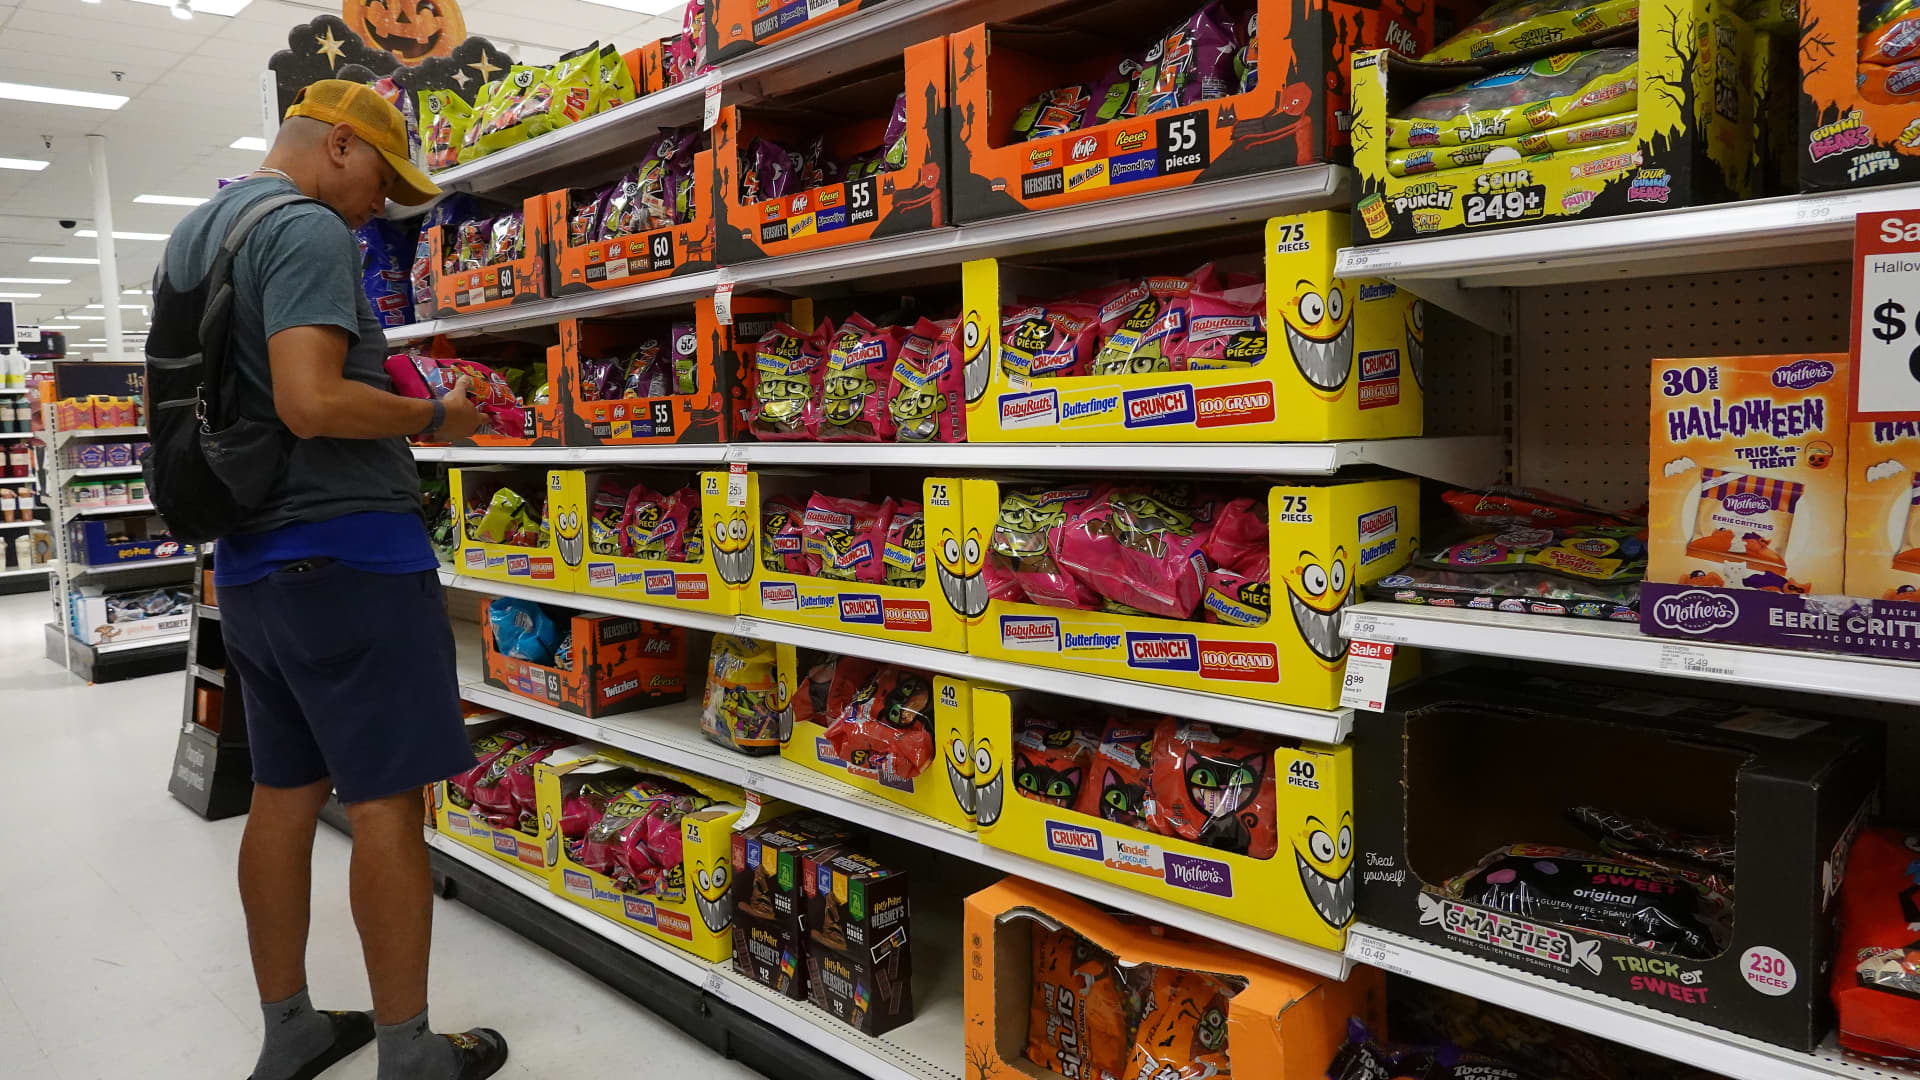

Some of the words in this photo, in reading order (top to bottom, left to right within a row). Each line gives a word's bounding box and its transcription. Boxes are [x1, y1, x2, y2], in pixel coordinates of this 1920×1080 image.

[1115, 129, 1149, 146] Reese's
[1169, 119, 1197, 152] 55
[1811, 127, 1870, 161] BEARS
[1030, 148, 1053, 161] Reese's
[1165, 153, 1201, 171] pieces
[1582, 157, 1629, 175] SMARTIES
[1638, 168, 1665, 179] SOUR
[1847, 158, 1900, 182] TAFFY
[1024, 173, 1062, 195] HERSHEY'S
[1404, 181, 1439, 198] SOUR
[1477, 169, 1531, 194] SOUR
[852, 182, 870, 208] 55
[1394, 191, 1454, 214] PUNCH
[851, 209, 873, 223] pieces
[1467, 191, 1540, 224] 249+
[762, 224, 787, 240] HERSHEY'S
[1279, 223, 1305, 243] 75
[653, 236, 669, 256] 60
[1278, 242, 1310, 253] PIECES
[654, 259, 671, 269] pieces
[1346, 257, 1368, 266] 9.99
[501, 270, 511, 288] 60
[1022, 321, 1048, 339] 75
[681, 338, 694, 351] 55
[1016, 337, 1047, 350] PIECES
[1238, 336, 1266, 349] 75
[846, 346, 881, 364] CRUNCH
[1226, 346, 1266, 358] PIECES
[1363, 356, 1396, 374] CRUNCH
[1662, 366, 1708, 397] 30
[1707, 365, 1719, 390] PACK
[1775, 364, 1834, 386] Mother's
[1062, 395, 1118, 417] Butterfinger
[1131, 392, 1185, 418] CRUNCH
[1199, 399, 1225, 413] 100
[1225, 394, 1269, 412] GRAND
[655, 404, 668, 424] 55
[1668, 398, 1824, 442] HALLOWEEN
[655, 424, 671, 435] pieces
[1748, 456, 1797, 470] TREAT
[551, 475, 560, 486] 75
[706, 478, 717, 489] 75
[931, 485, 947, 498] 75
[930, 498, 950, 507] PIECES
[1282, 495, 1308, 513] 75
[1725, 497, 1771, 513] Mother's
[1281, 513, 1314, 523] PIECES
[1712, 514, 1735, 524] EERIE
[1735, 519, 1774, 531] CRITTERS
[836, 545, 868, 567] CRUNCH
[1360, 538, 1397, 566] Butterfinger
[1551, 550, 1596, 566] SUGAR
[647, 575, 671, 589] CRUNCH
[800, 594, 835, 608] Butterfinger
[1240, 590, 1270, 605] PIEC
[843, 600, 877, 616] CRUNCH
[885, 609, 901, 620] 100
[902, 609, 929, 622] GRAND
[1205, 592, 1264, 625] Butterfinger
[1661, 601, 1734, 622] Mother's
[1881, 607, 1917, 618] BATCH
[158, 619, 189, 630] HERSHEY'S
[1353, 623, 1375, 632] 9.99
[1768, 607, 1840, 631] EERIE
[1064, 632, 1121, 649] Butterfinger
[1833, 634, 1911, 649] COOKIES
[1133, 640, 1189, 660] CRUNCH
[1349, 642, 1381, 657] Sale!
[1202, 651, 1226, 666] 100
[1227, 653, 1273, 670] GRAND
[1683, 656, 1709, 667] 12.49
[548, 674, 558, 691] 65
[602, 678, 638, 699] Twizzlers
[941, 685, 956, 700] 40
[940, 697, 959, 708] PIECES
[1048, 730, 1072, 742] 40
[1289, 760, 1315, 779] 40
[1287, 776, 1321, 791] PIECES
[687, 823, 699, 837] 75
[1053, 830, 1095, 848] CRUNCH
[1116, 841, 1148, 857] Kinder
[1118, 852, 1149, 865] CHOCOLATE
[1365, 852, 1395, 867] Treat
[1173, 862, 1224, 884] Mother's
[1363, 869, 1406, 888] yourself!
[1582, 863, 1653, 879] TRICK
[1591, 873, 1681, 896] SWEET
[1572, 888, 1638, 905] original
[1540, 897, 1573, 910] GLUTEN
[1574, 904, 1596, 914] FREE
[871, 905, 905, 929] HERSHEY'S
[1447, 911, 1567, 954] SMARTIES
[749, 938, 781, 967] HERSHEY'S
[1360, 946, 1386, 961] 10.49
[759, 966, 770, 981] 42
[1612, 955, 1680, 979] TRICK
[1680, 969, 1703, 985] or
[1749, 952, 1787, 978] 230
[822, 968, 854, 999] HERSHEY'S
[1629, 975, 1709, 1004] SWEET
[1747, 972, 1788, 991] PIECES
[833, 999, 844, 1014] 42
